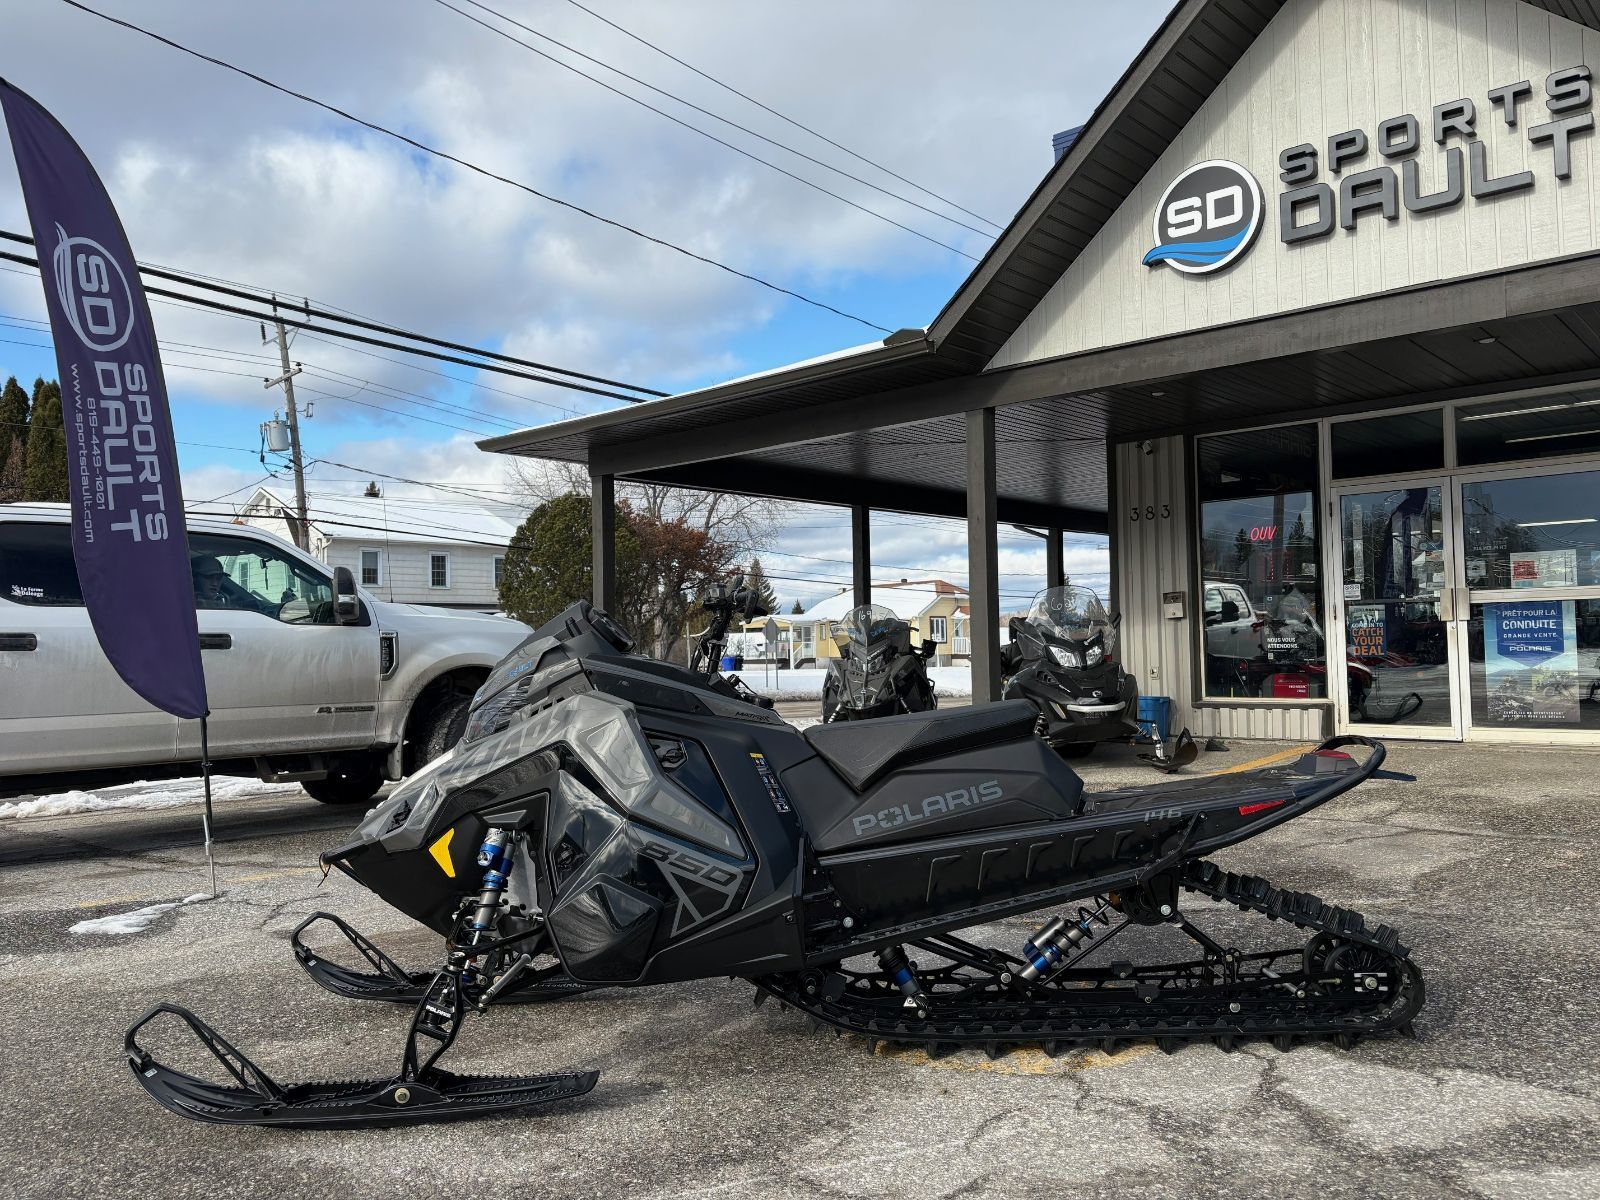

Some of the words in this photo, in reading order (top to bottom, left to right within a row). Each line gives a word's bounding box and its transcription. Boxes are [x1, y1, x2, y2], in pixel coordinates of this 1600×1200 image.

[1279, 65, 1592, 185] SPORTS
[1280, 112, 1595, 245] DAULT
[1167, 185, 1244, 238] SD
[77, 254, 117, 335] SD
[71, 363, 94, 543] www.sportsdault.com
[87, 397, 106, 510] 819-449-1001
[94, 361, 142, 541] DAULT
[124, 363, 169, 540] SPORTS
[1130, 504, 1171, 521] 383
[1250, 525, 1277, 541] OUV
[1352, 627, 1384, 636] CATCH
[1352, 636, 1384, 646] YOUR
[1353, 645, 1385, 656] DEAL
[1502, 619, 1557, 630] CONDUITE
[852, 779, 1004, 836] POLARIS
[1143, 807, 1183, 823] 146
[634, 840, 739, 888] 850
